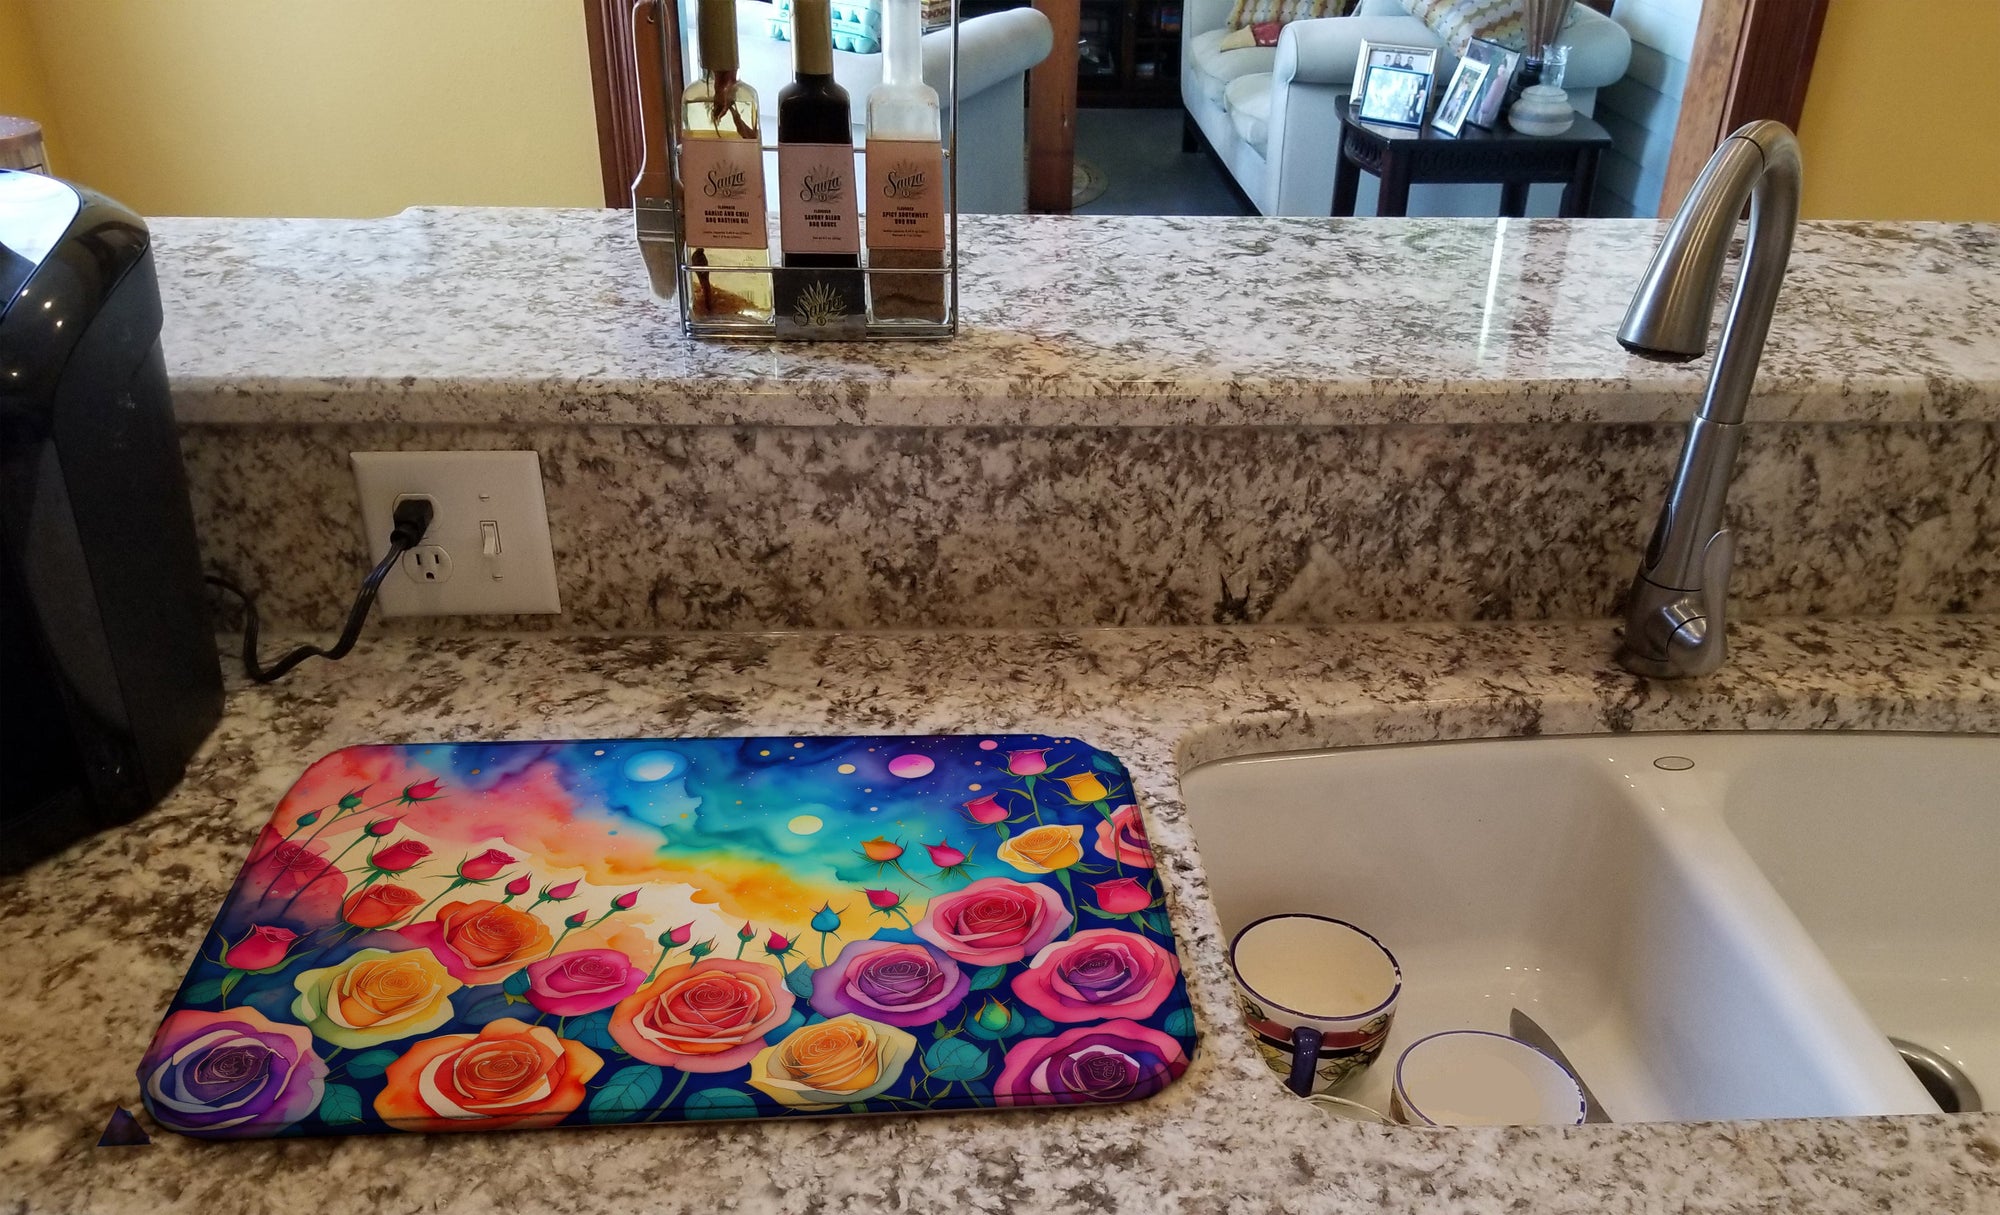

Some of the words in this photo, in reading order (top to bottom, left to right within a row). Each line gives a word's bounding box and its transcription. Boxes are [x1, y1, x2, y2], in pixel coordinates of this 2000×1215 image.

[703, 170, 746, 197] Sauza
[799, 175, 842, 202] Sauza
[883, 171, 925, 198] Sauza
[792, 295, 843, 327] Sauza
